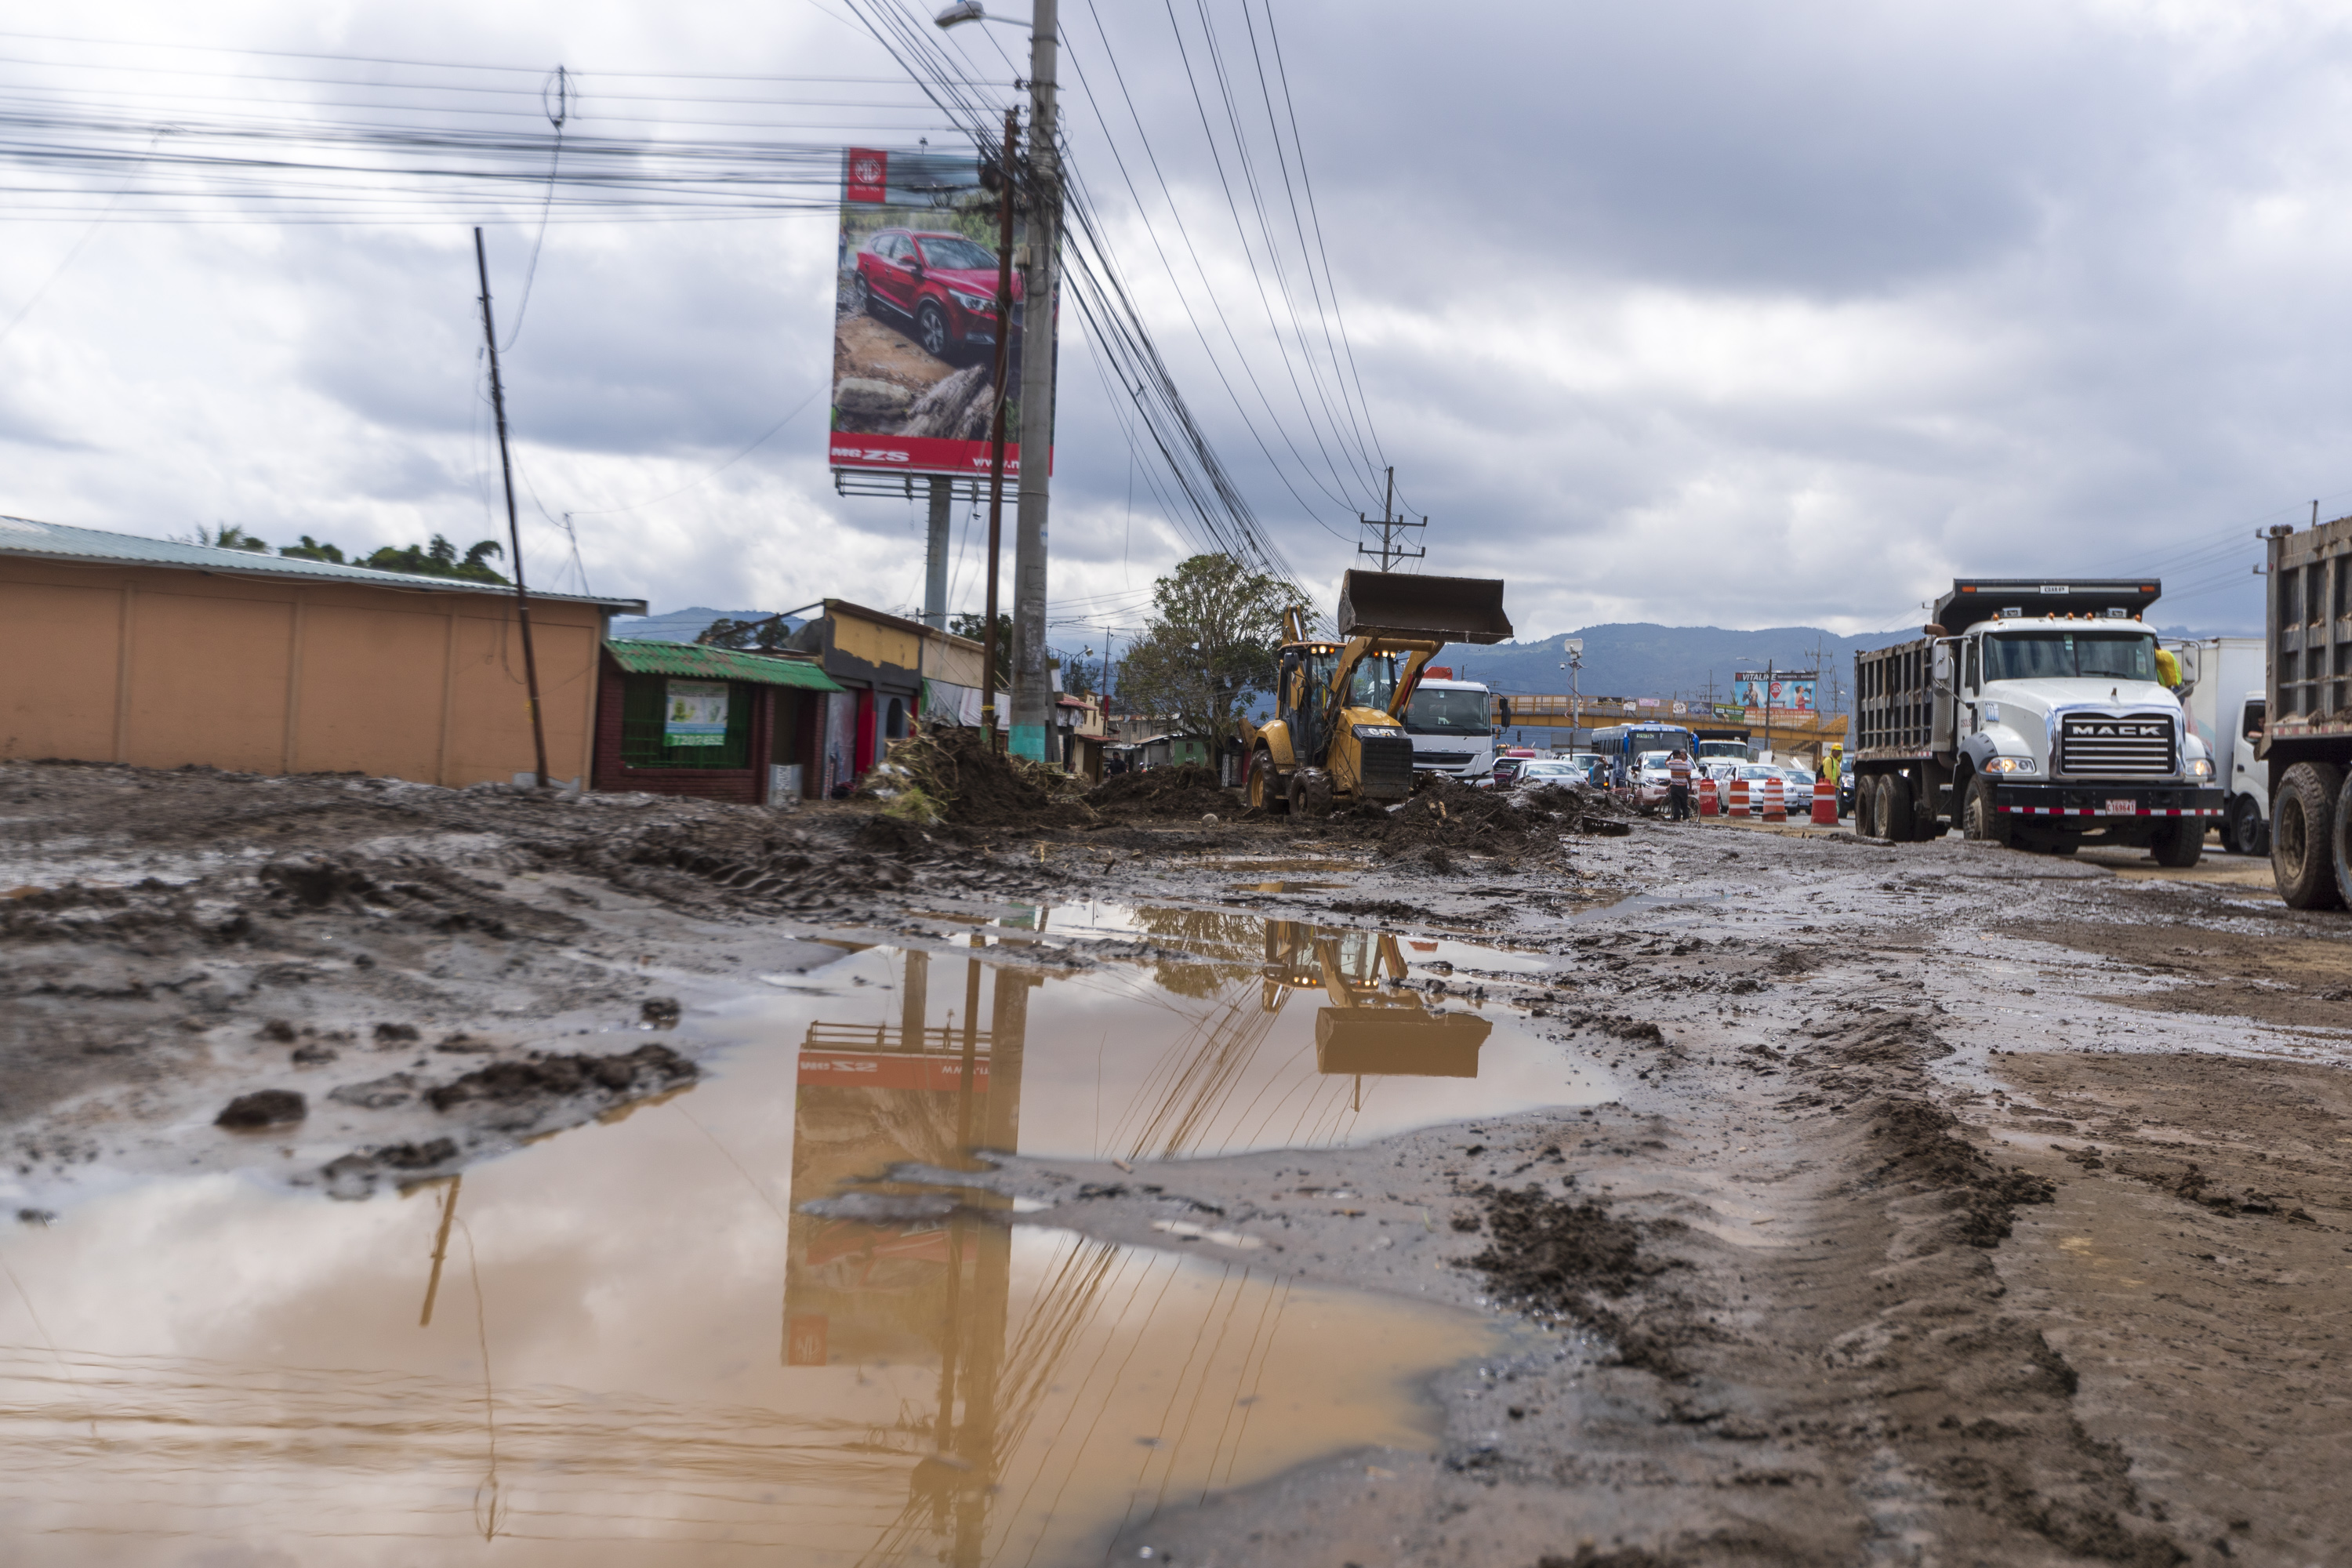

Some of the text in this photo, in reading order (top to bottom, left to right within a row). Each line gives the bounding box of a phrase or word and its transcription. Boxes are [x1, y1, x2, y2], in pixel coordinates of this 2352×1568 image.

[831, 448, 909, 462] MG ZS
[1367, 728, 1397, 737] CAT
[2072, 726, 2161, 735] MACK
